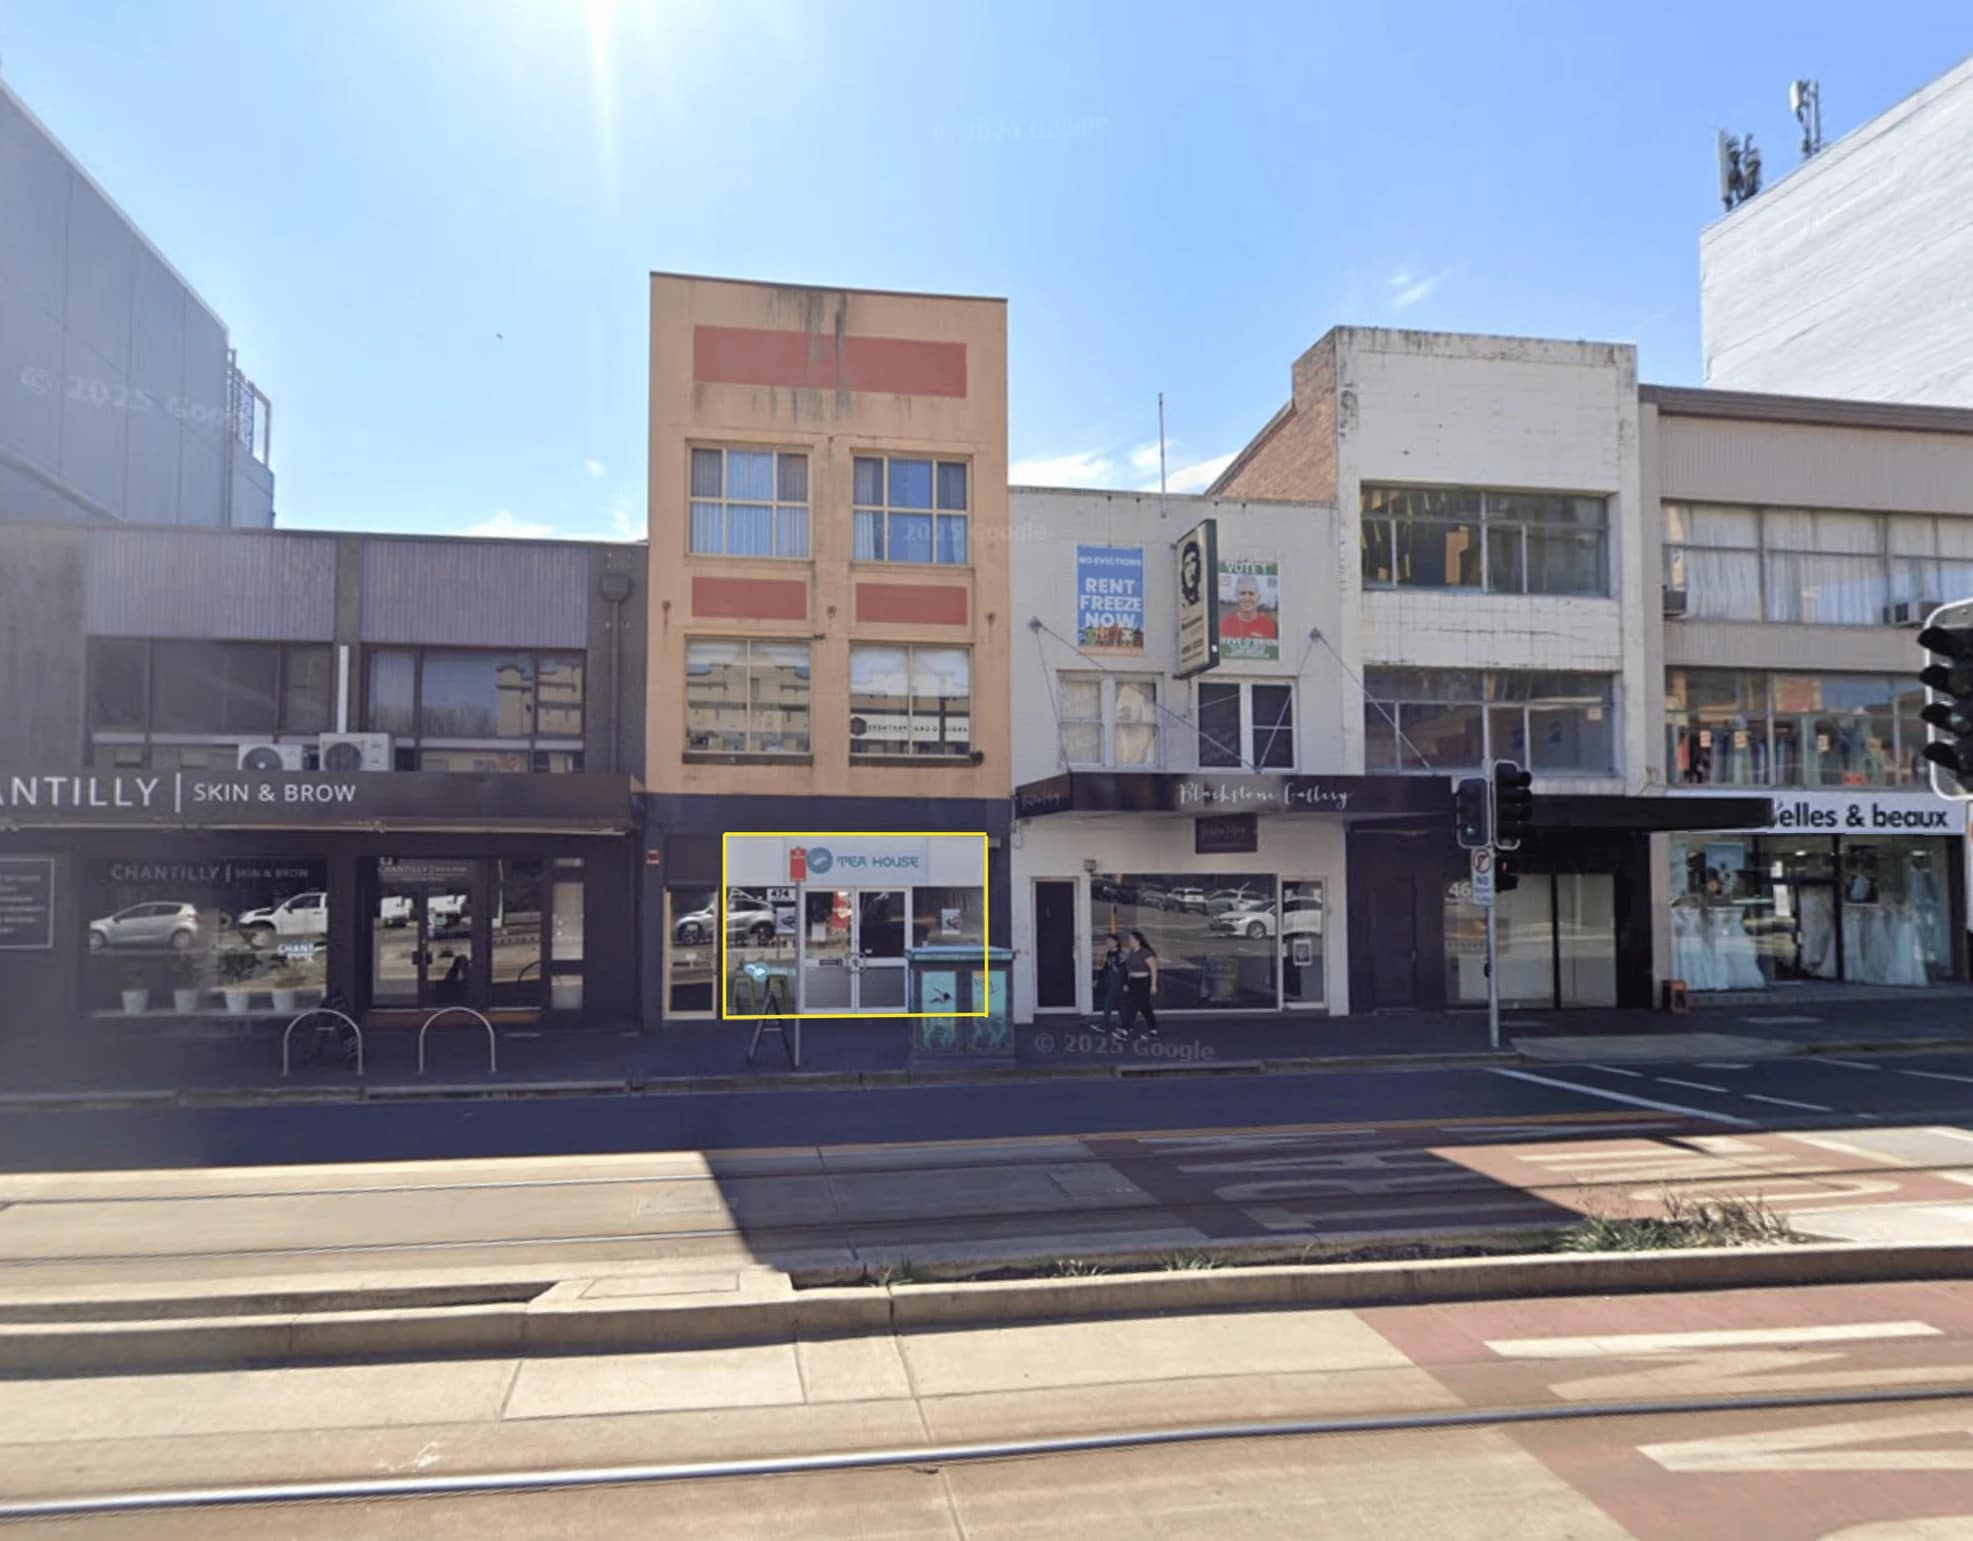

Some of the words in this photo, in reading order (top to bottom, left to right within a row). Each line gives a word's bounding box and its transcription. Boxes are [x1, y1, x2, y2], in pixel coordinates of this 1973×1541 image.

[1085, 578, 1136, 594] RENT
[1080, 595, 1142, 611] FREEZE
[1085, 611, 1136, 628] NOW
[0, 776, 159, 807] NTILLY
[193, 783, 249, 802] SKIN
[259, 784, 275, 802] &
[284, 784, 356, 802] BROW
[1179, 782, 1275, 805] Blackstone
[1283, 782, 1353, 809] Gallery
[1773, 801, 1838, 828] elles
[1846, 804, 1866, 828] &
[1872, 803, 1949, 828] beaux
[837, 855, 868, 868] TEA
[873, 855, 920, 868] HOUSE
[110, 863, 220, 881] CHANTILLY
